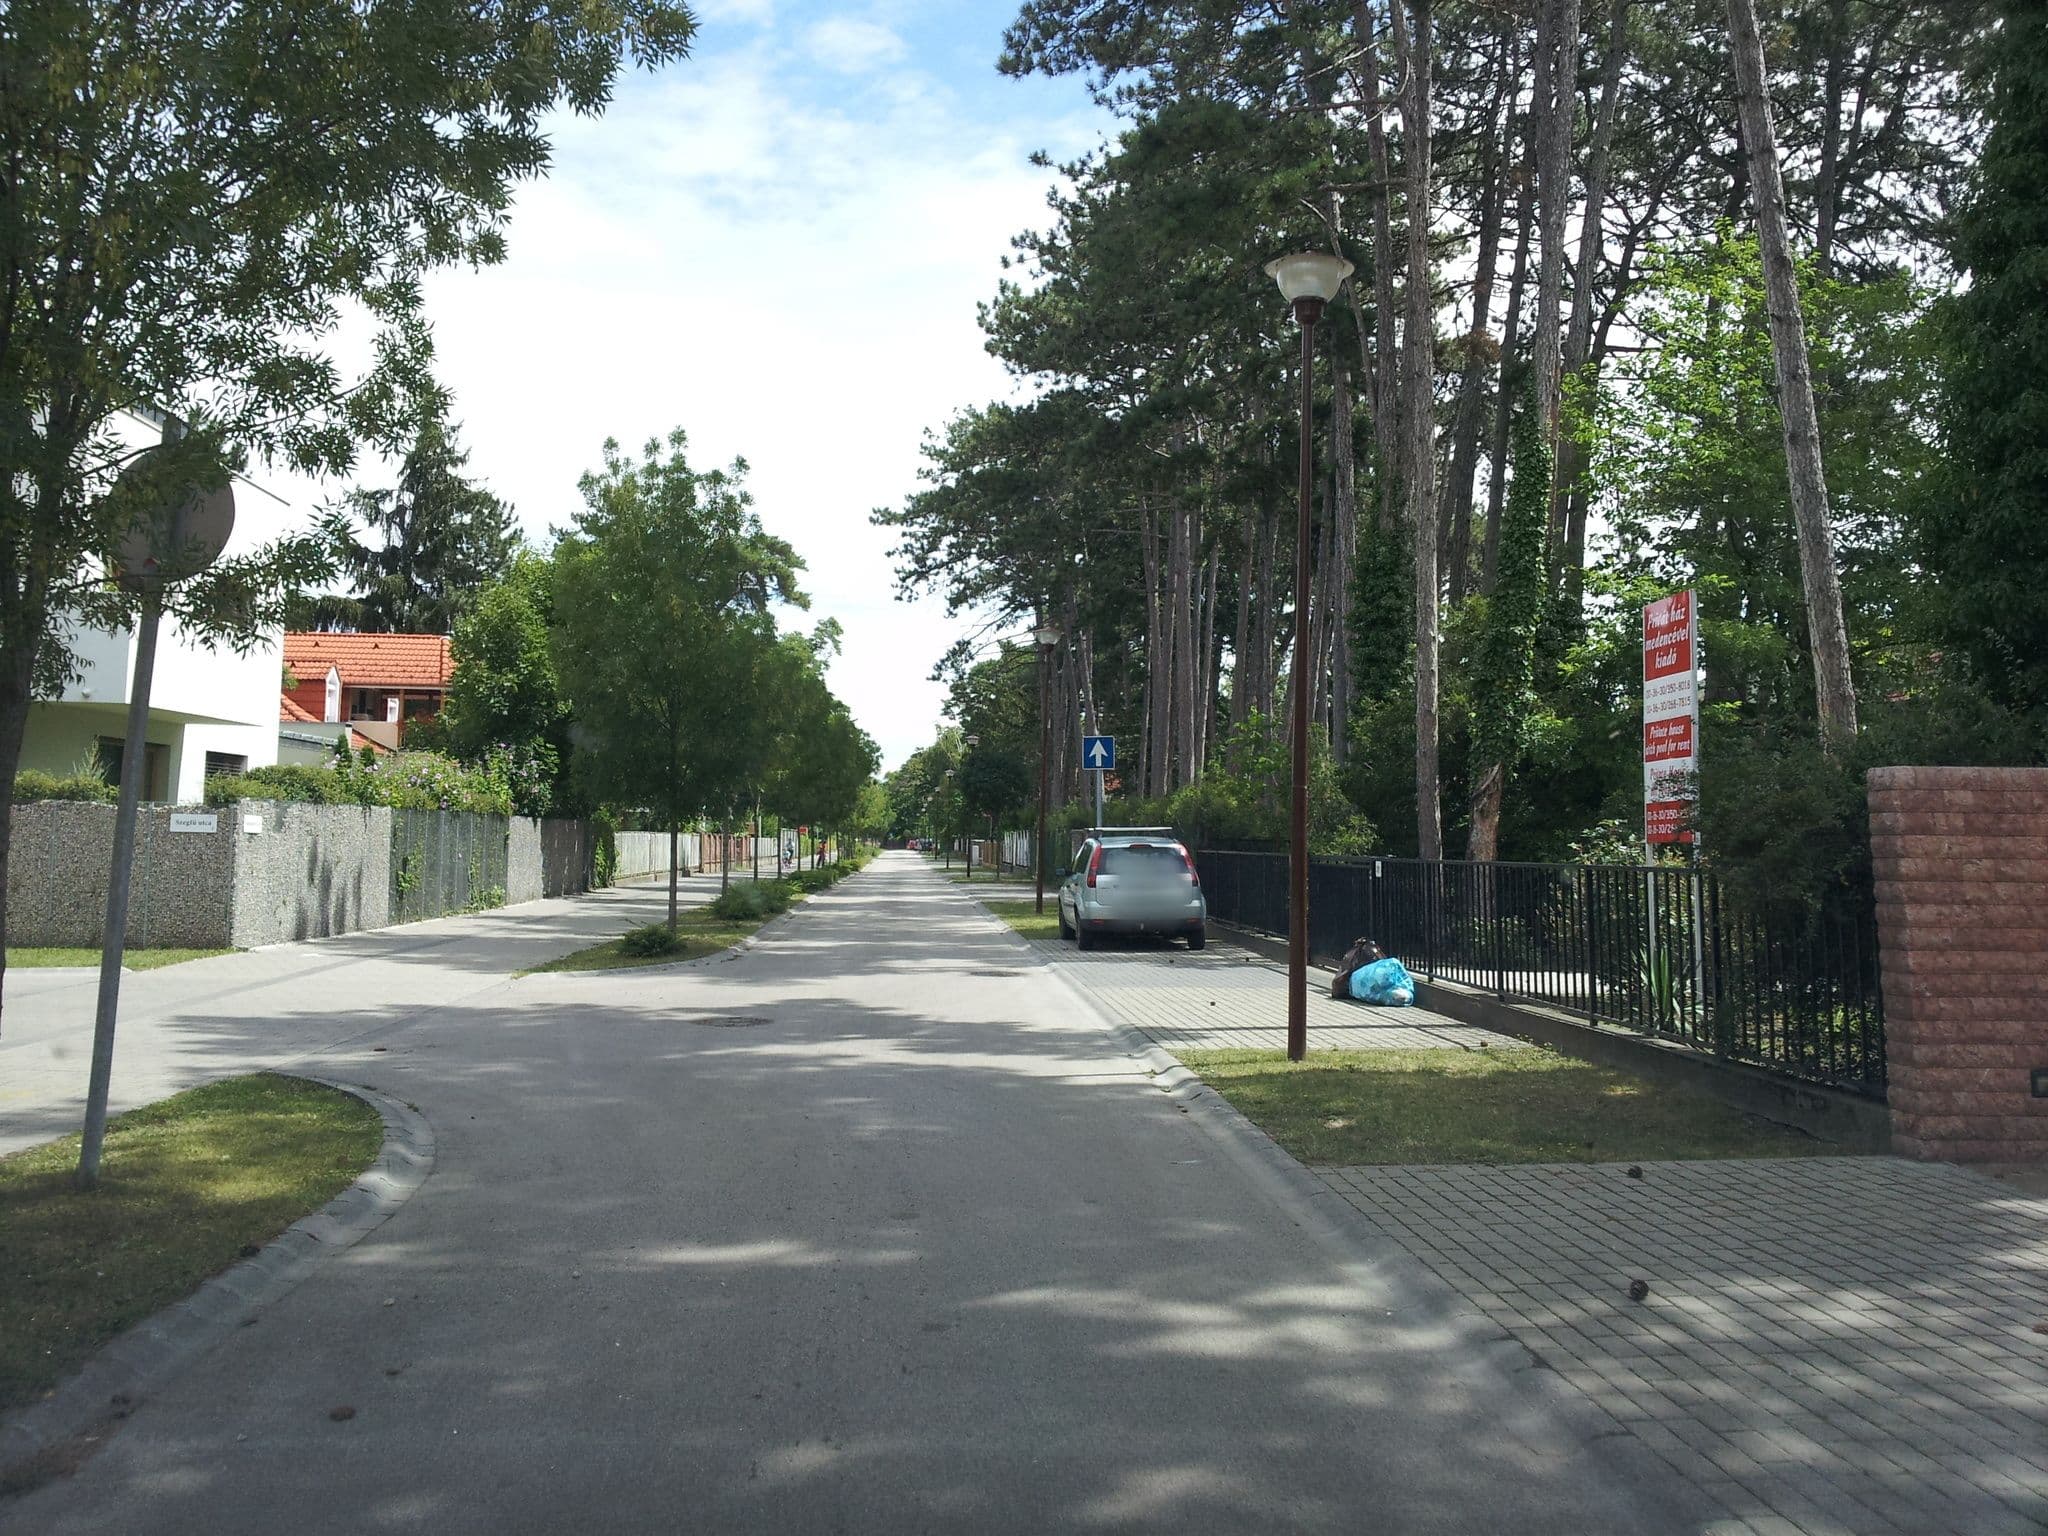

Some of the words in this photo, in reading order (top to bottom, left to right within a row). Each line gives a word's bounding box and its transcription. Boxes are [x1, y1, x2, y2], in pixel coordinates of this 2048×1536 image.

[1670, 604, 1686, 623] ház
[1645, 623, 1689, 650] medencével
[1655, 648, 1678, 669] kiadó
[1668, 722, 1685, 737] house
[1677, 740, 1691, 752] rent
